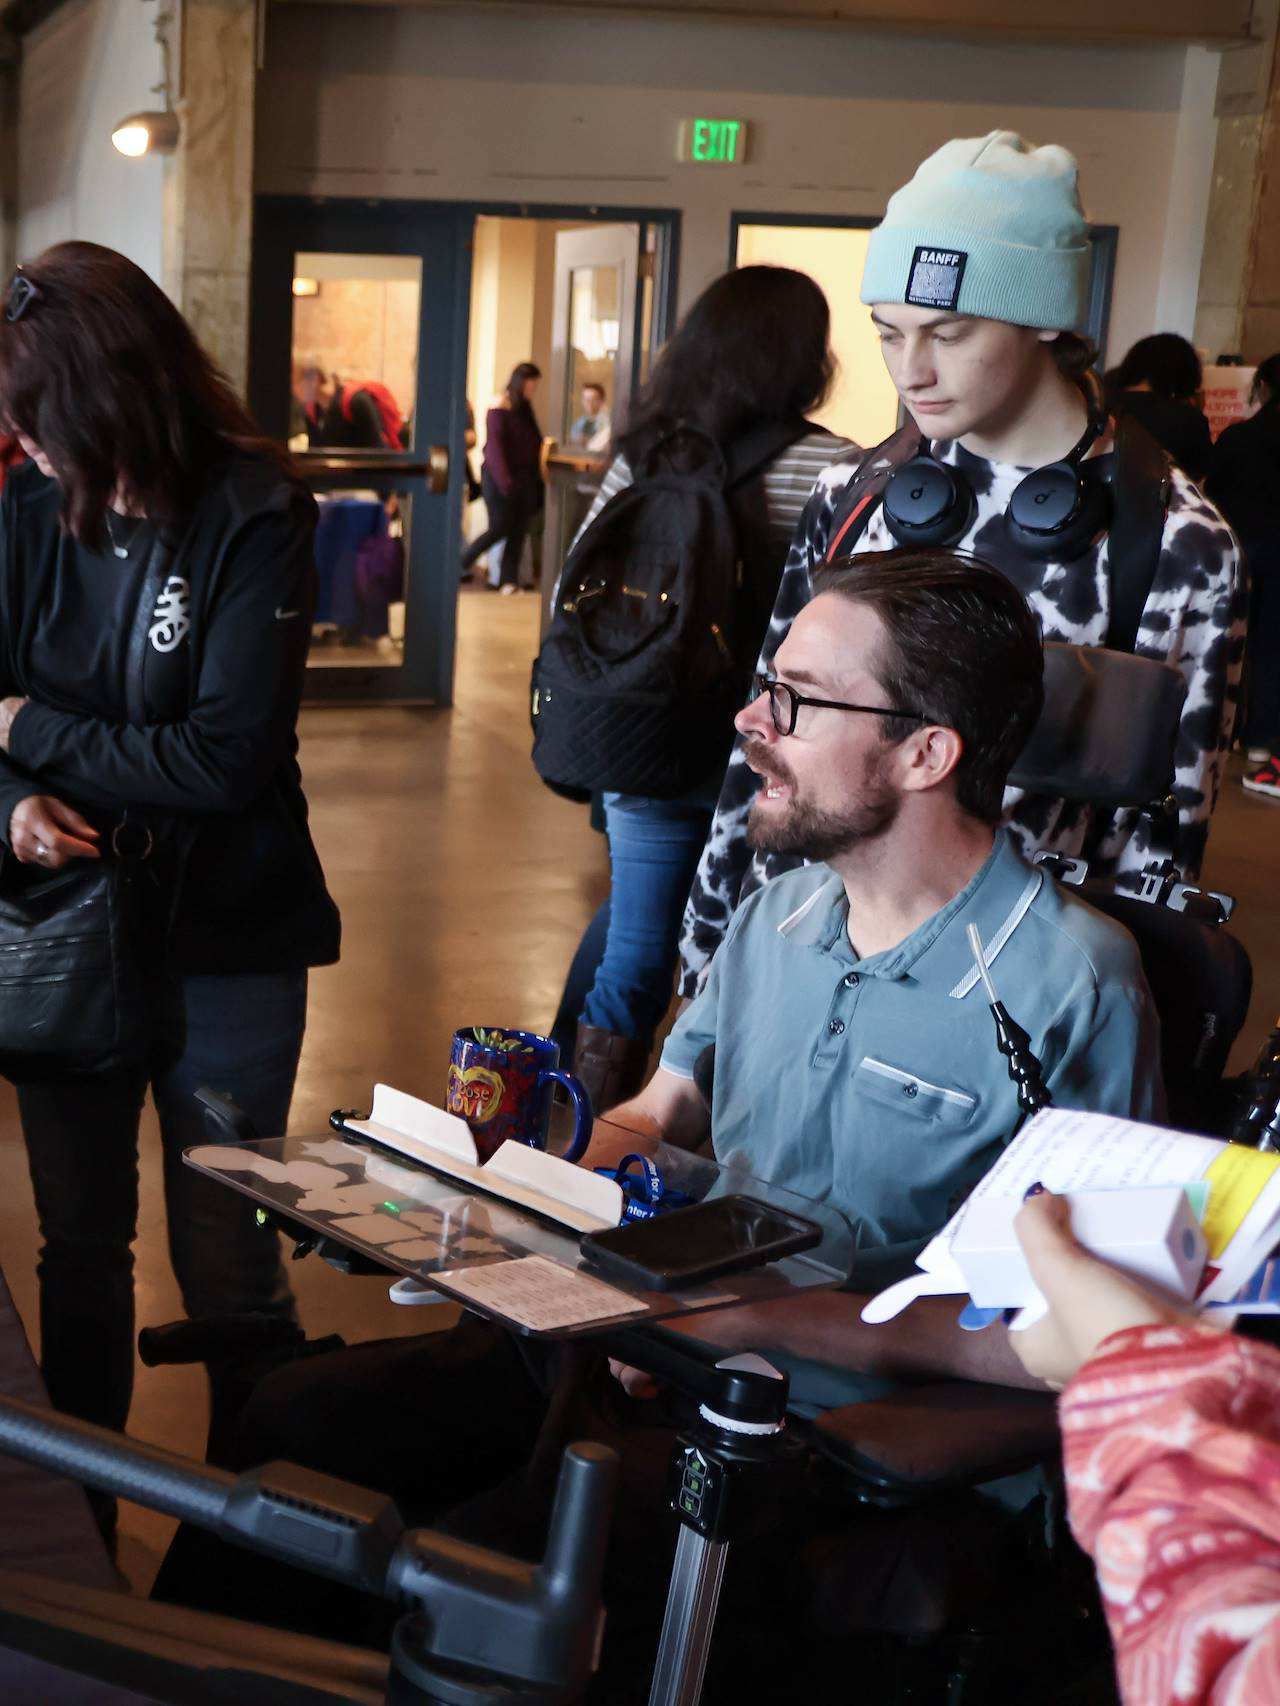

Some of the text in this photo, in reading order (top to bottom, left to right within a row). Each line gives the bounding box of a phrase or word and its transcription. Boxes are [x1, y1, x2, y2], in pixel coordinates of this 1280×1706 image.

[694, 119, 739, 161] EXIT
[920, 250, 960, 266] BANFF
[650, 1177, 660, 1193] for
[626, 1205, 648, 1219] nter
